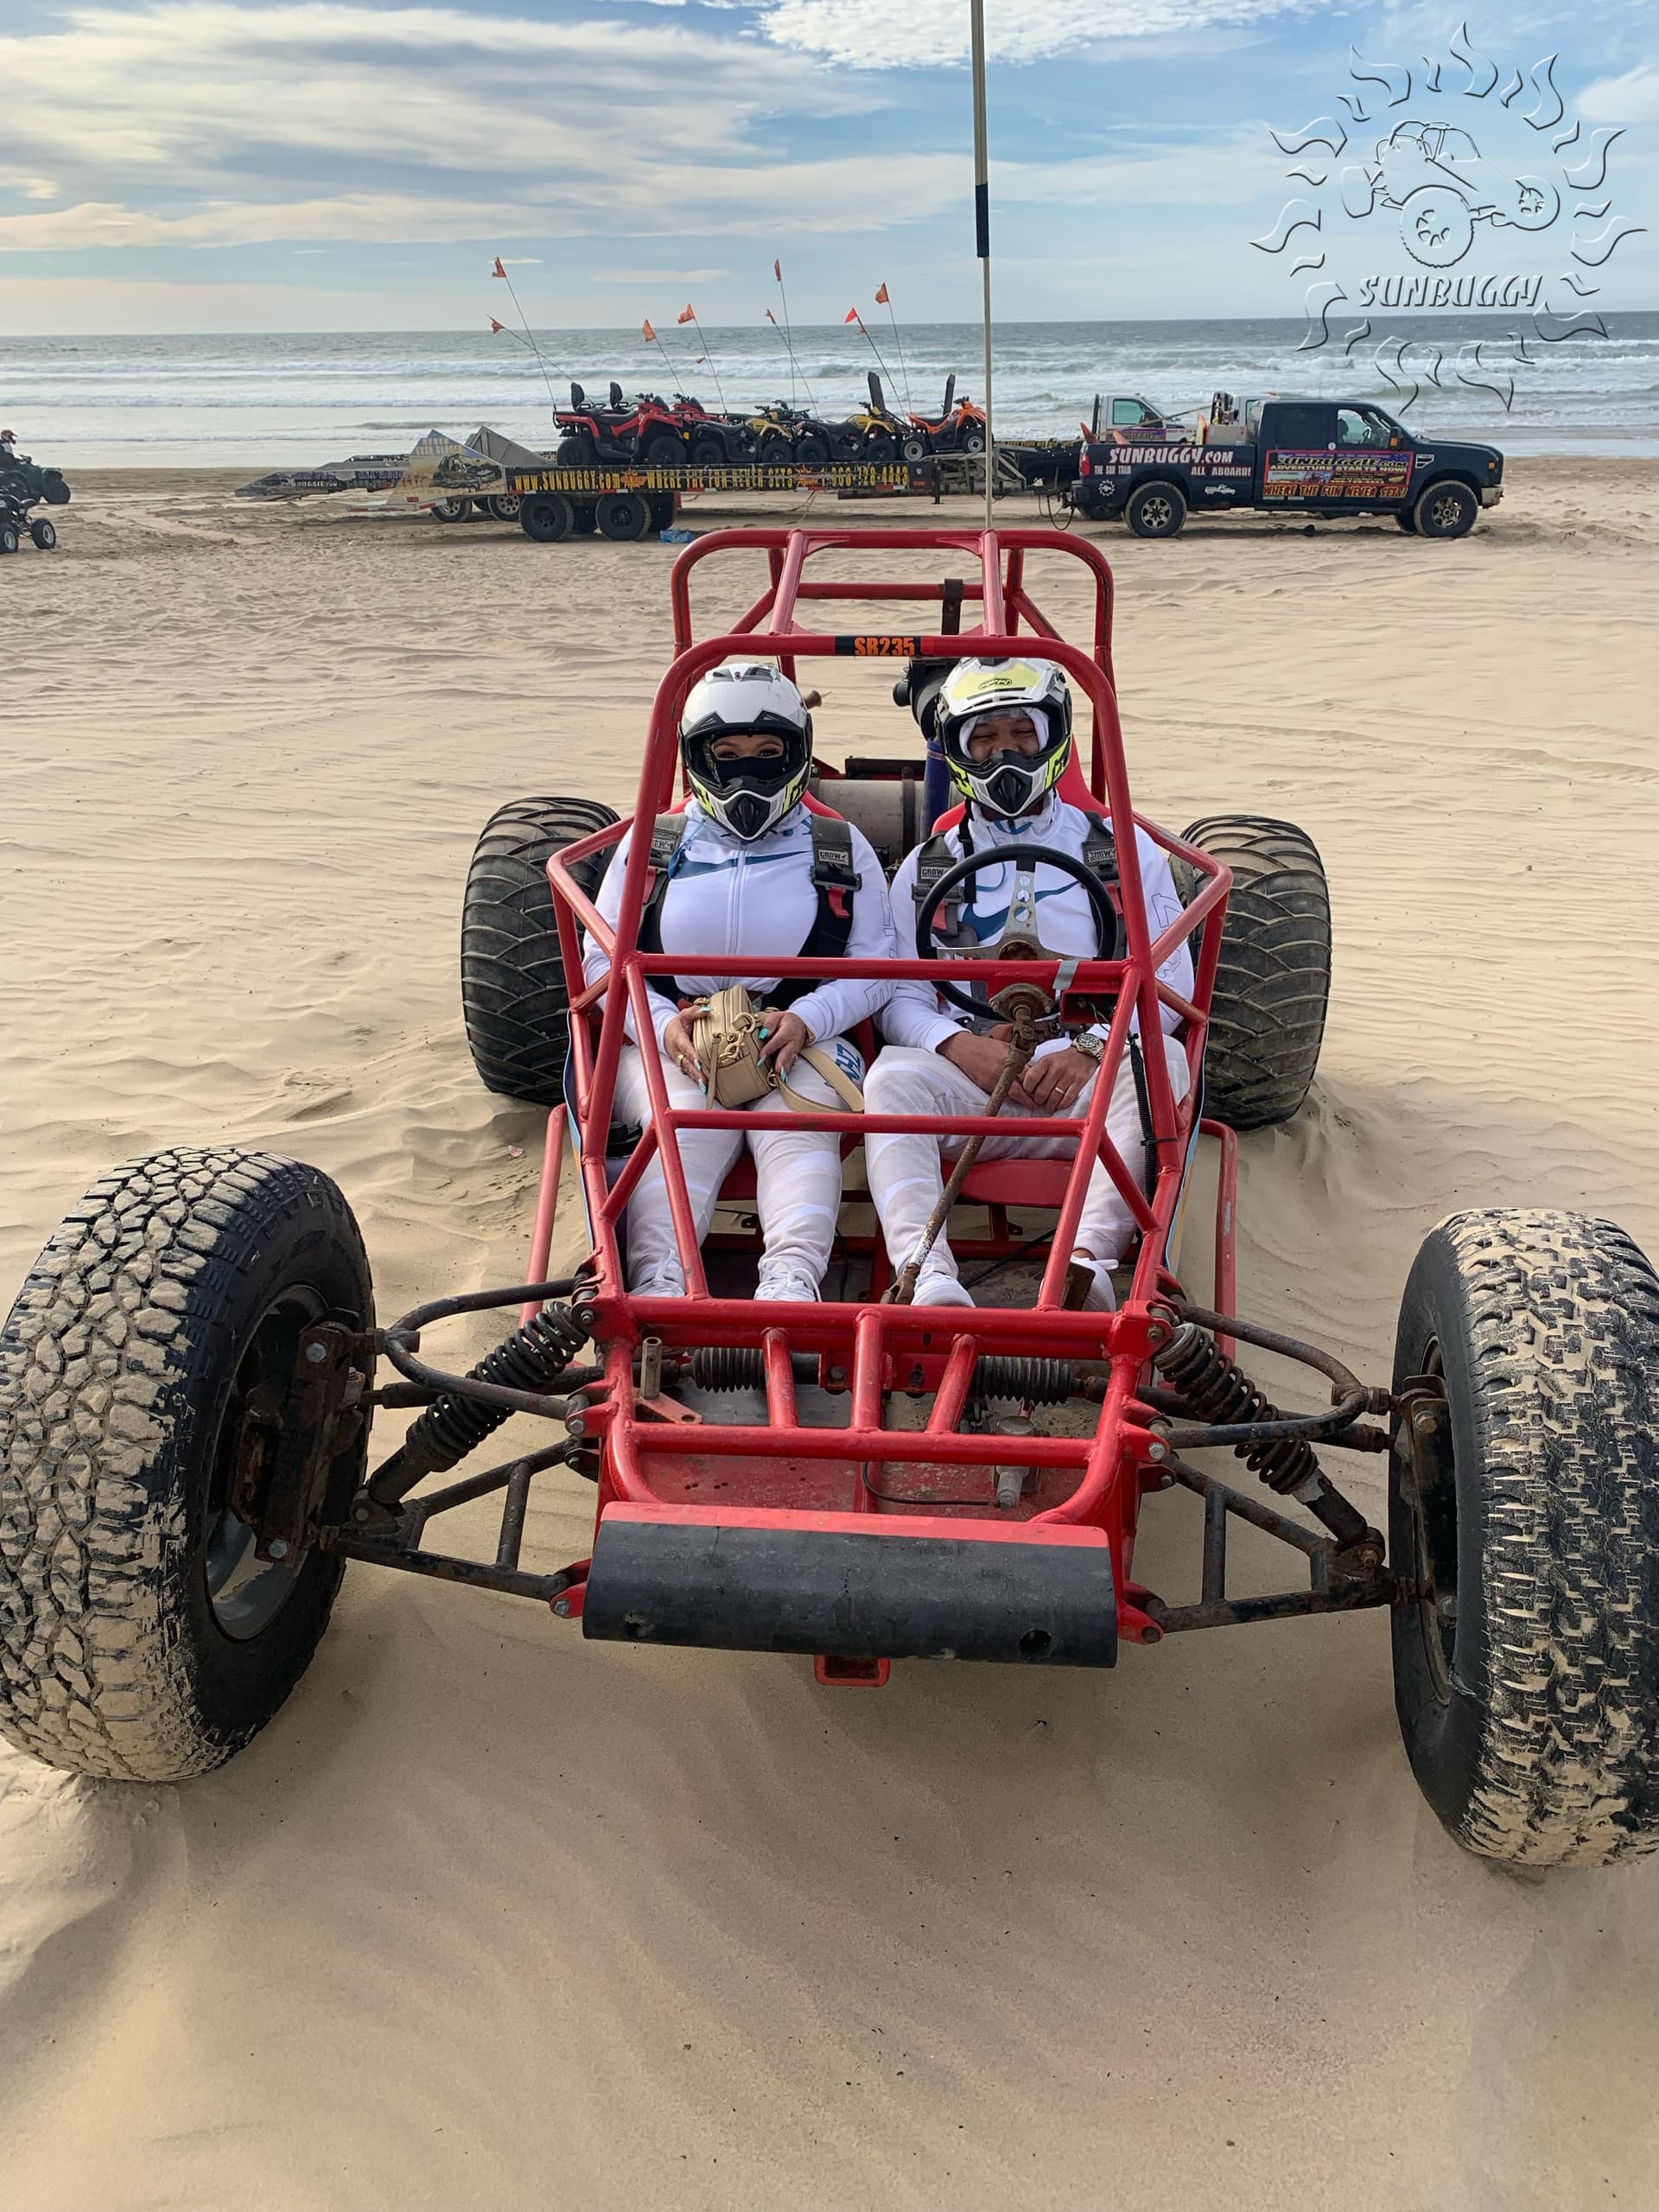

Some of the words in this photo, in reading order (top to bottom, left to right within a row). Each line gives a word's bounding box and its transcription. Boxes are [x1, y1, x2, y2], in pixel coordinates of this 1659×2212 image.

[1109, 447, 1234, 464] SUNBUGGY.COM
[646, 469, 682, 489] WHERE
[685, 469, 704, 488] THE
[1191, 466, 1206, 476] ALL
[1263, 484, 1297, 496] WHERE
[1300, 485, 1319, 497] THE
[1321, 485, 1343, 497] FUN
[1344, 486, 1377, 498] NEVER
[854, 637, 916, 657] SB235
